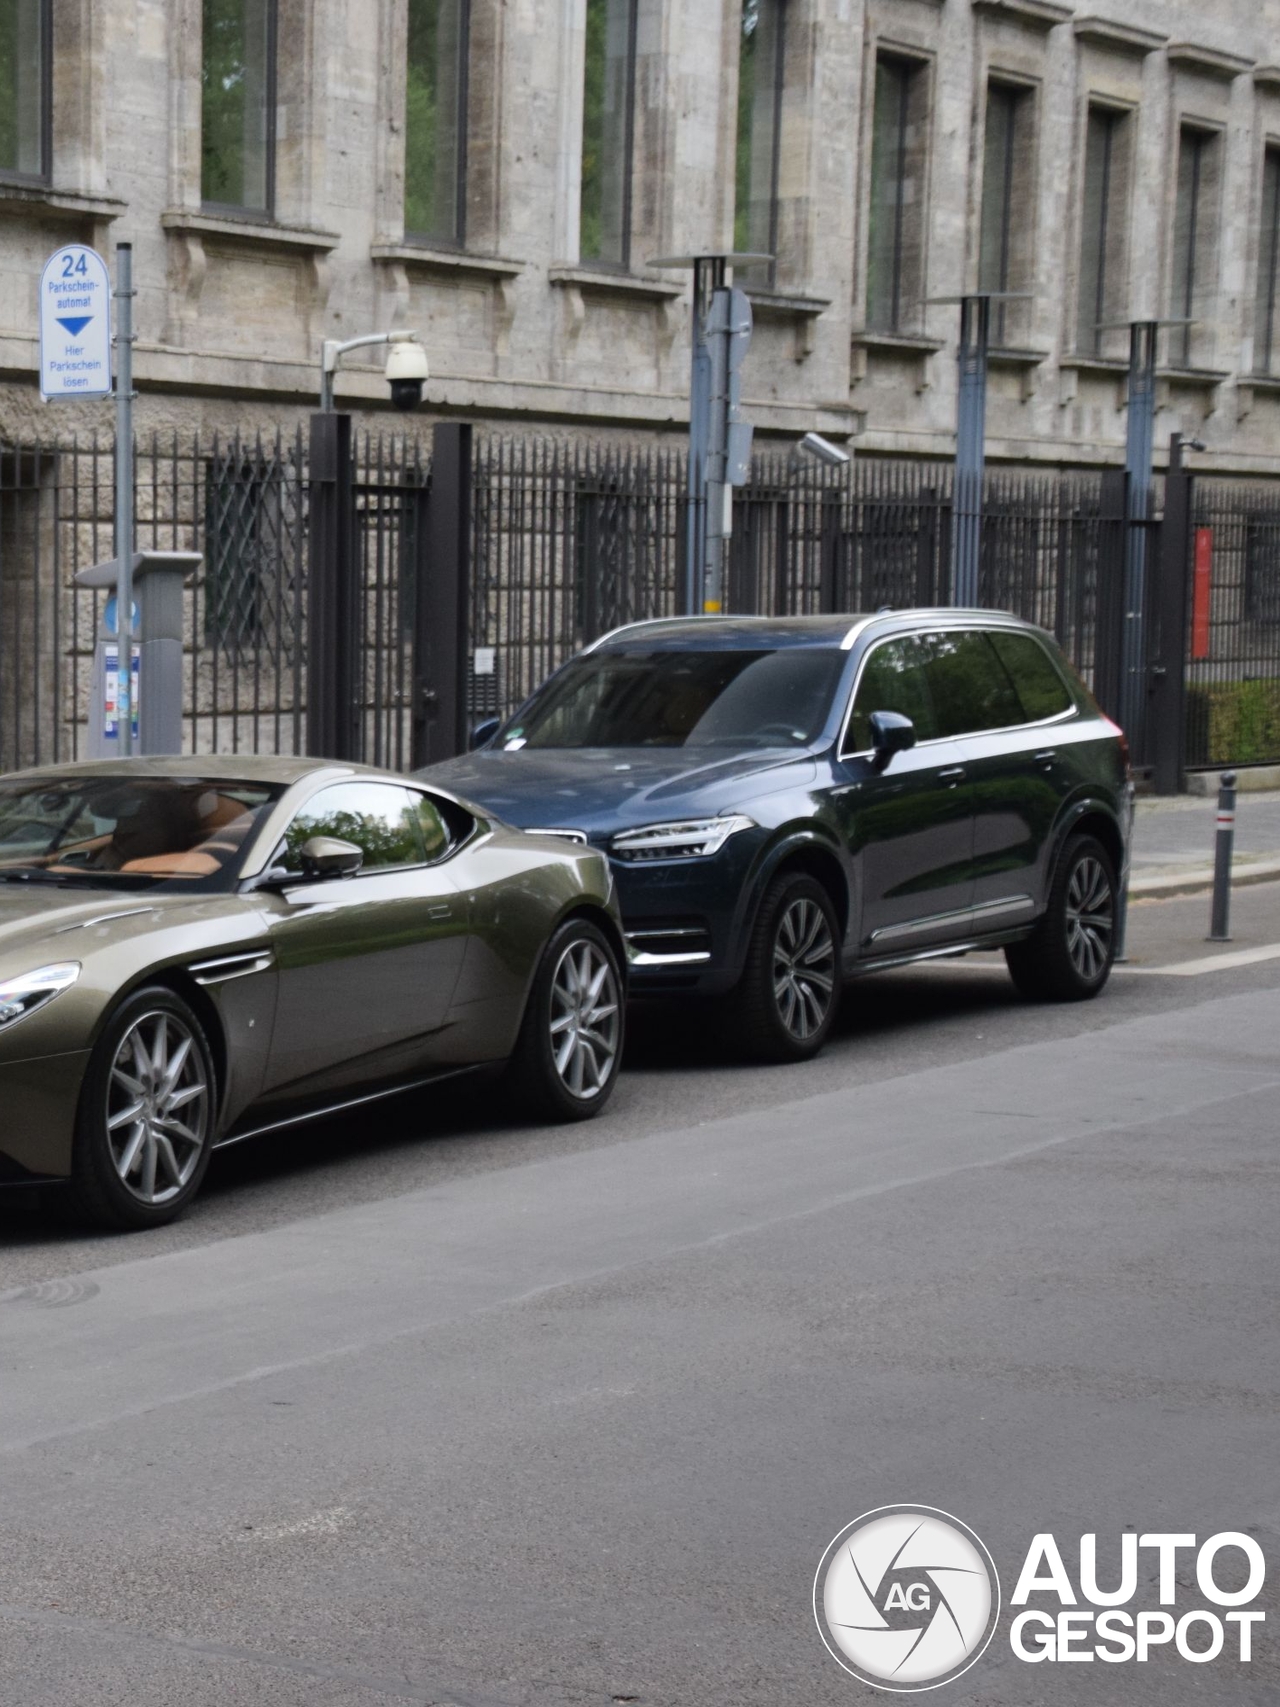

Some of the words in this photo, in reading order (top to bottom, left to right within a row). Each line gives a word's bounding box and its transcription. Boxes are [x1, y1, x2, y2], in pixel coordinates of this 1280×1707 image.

[62, 254, 88, 278] 24
[49, 281, 100, 293] Parkschein-
[57, 296, 91, 309] automat
[65, 346, 85, 356] Hier
[50, 360, 101, 372] Parkschein
[63, 376, 88, 387] lösen
